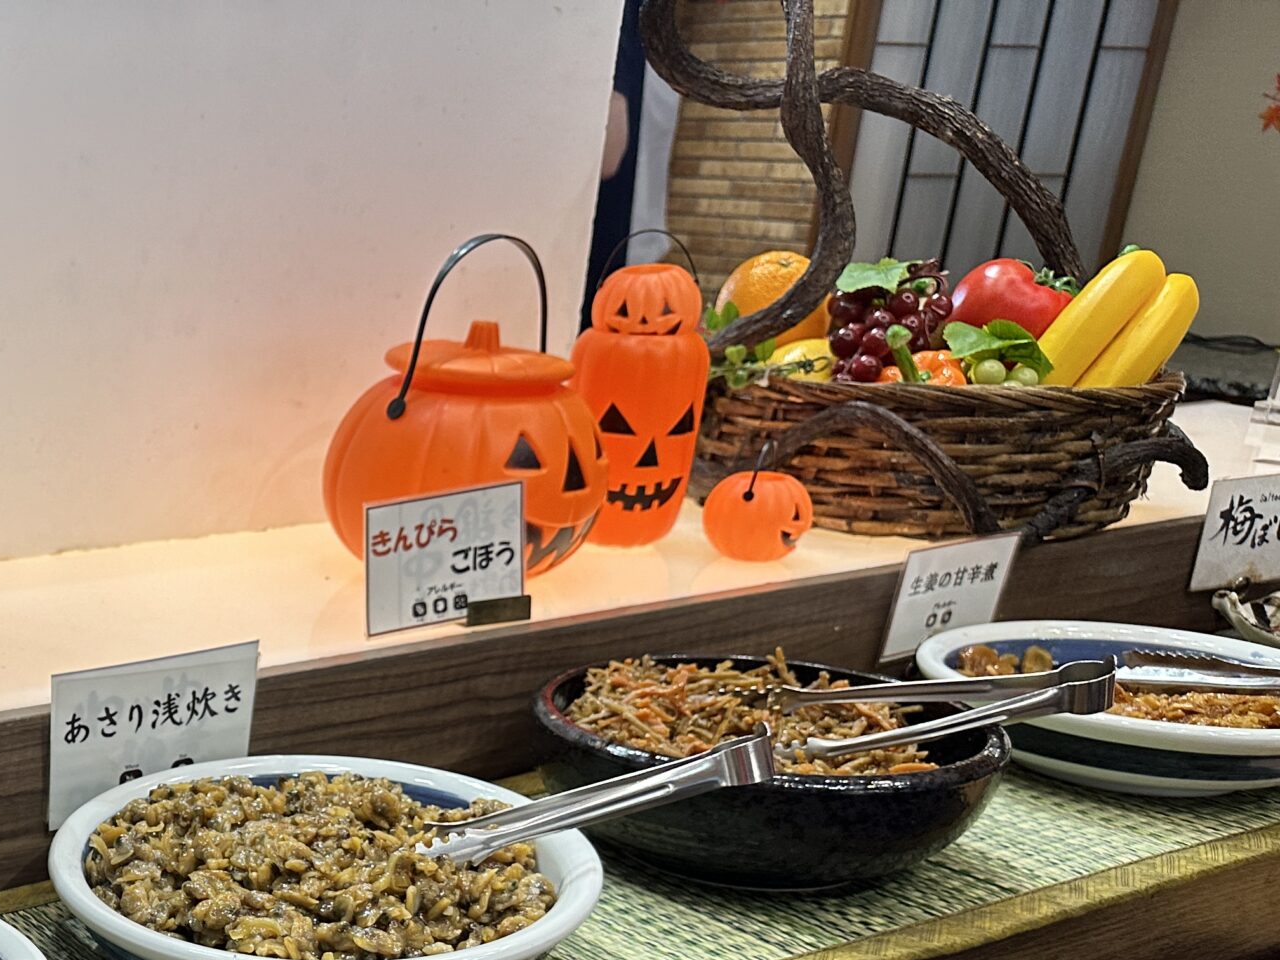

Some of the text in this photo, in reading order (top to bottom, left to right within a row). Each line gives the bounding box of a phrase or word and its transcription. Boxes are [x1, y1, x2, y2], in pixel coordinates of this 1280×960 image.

[372, 519, 458, 557] きんぴら
[908, 562, 998, 597] 生姜の甘辛煮
[63, 683, 242, 744] あさり浅炊き
